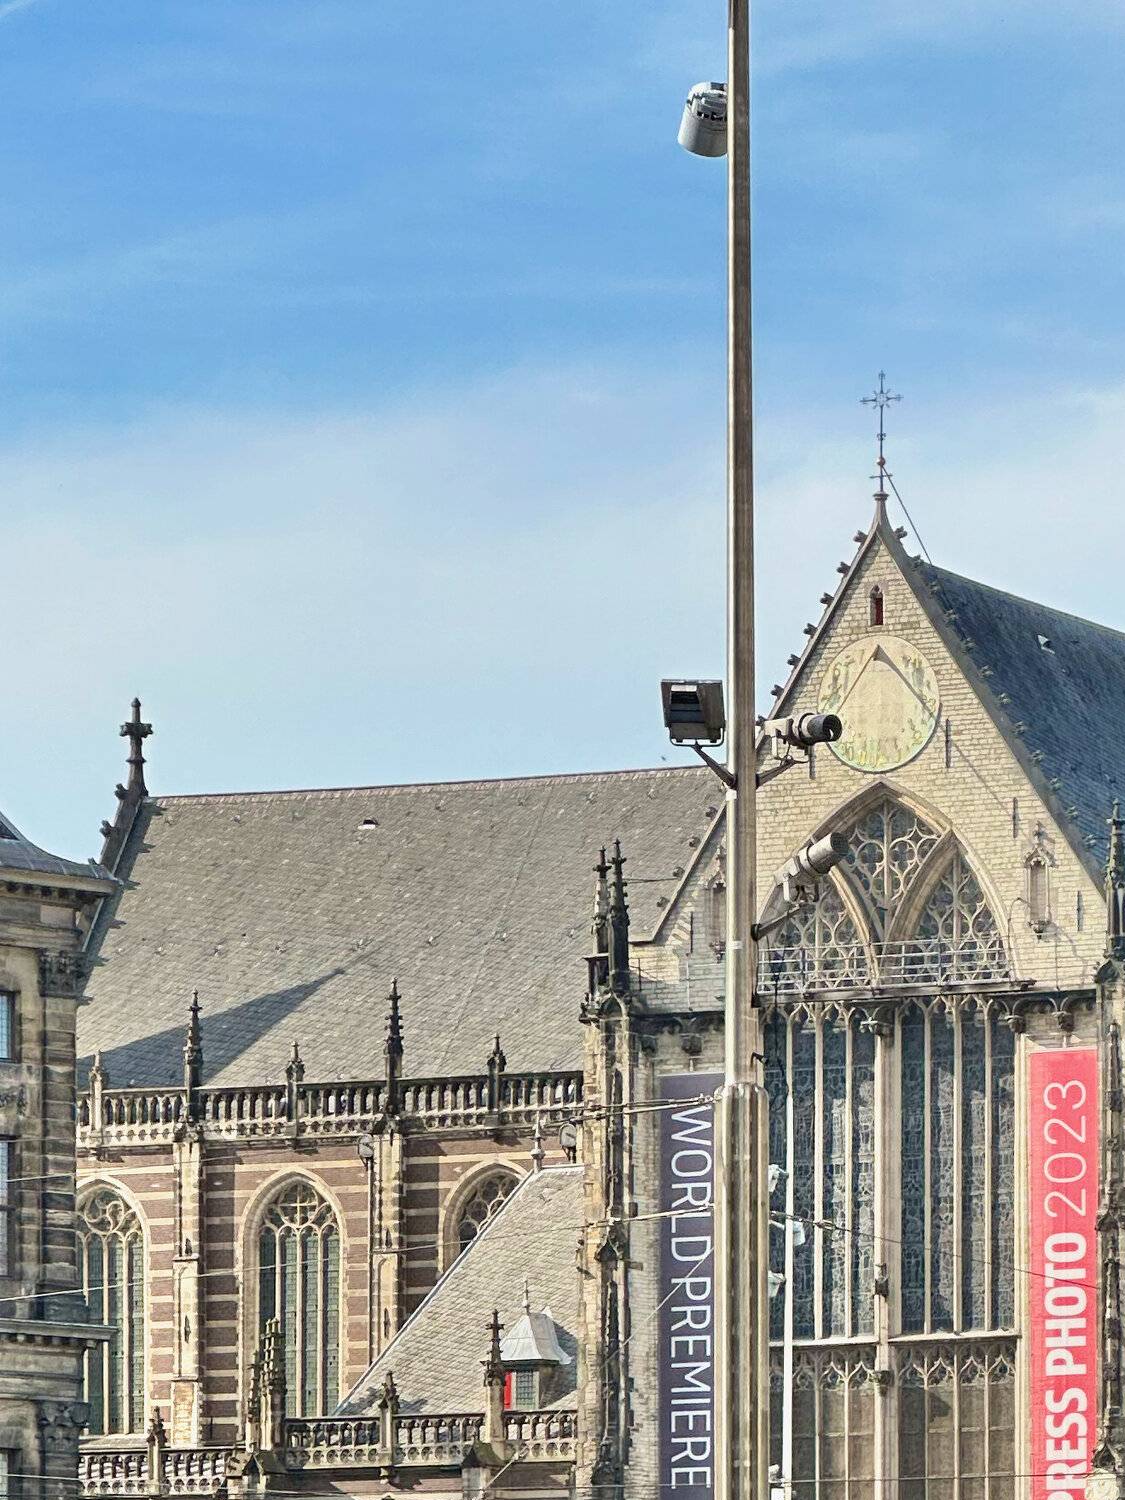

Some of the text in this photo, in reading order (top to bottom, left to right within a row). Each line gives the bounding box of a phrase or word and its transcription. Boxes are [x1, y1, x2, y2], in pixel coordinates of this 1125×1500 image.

[1043, 1079, 1088, 1218] 2023
[670, 1105, 712, 1489] WORLD PREMIERE
[1044, 1232, 1088, 1376] PHOTO
